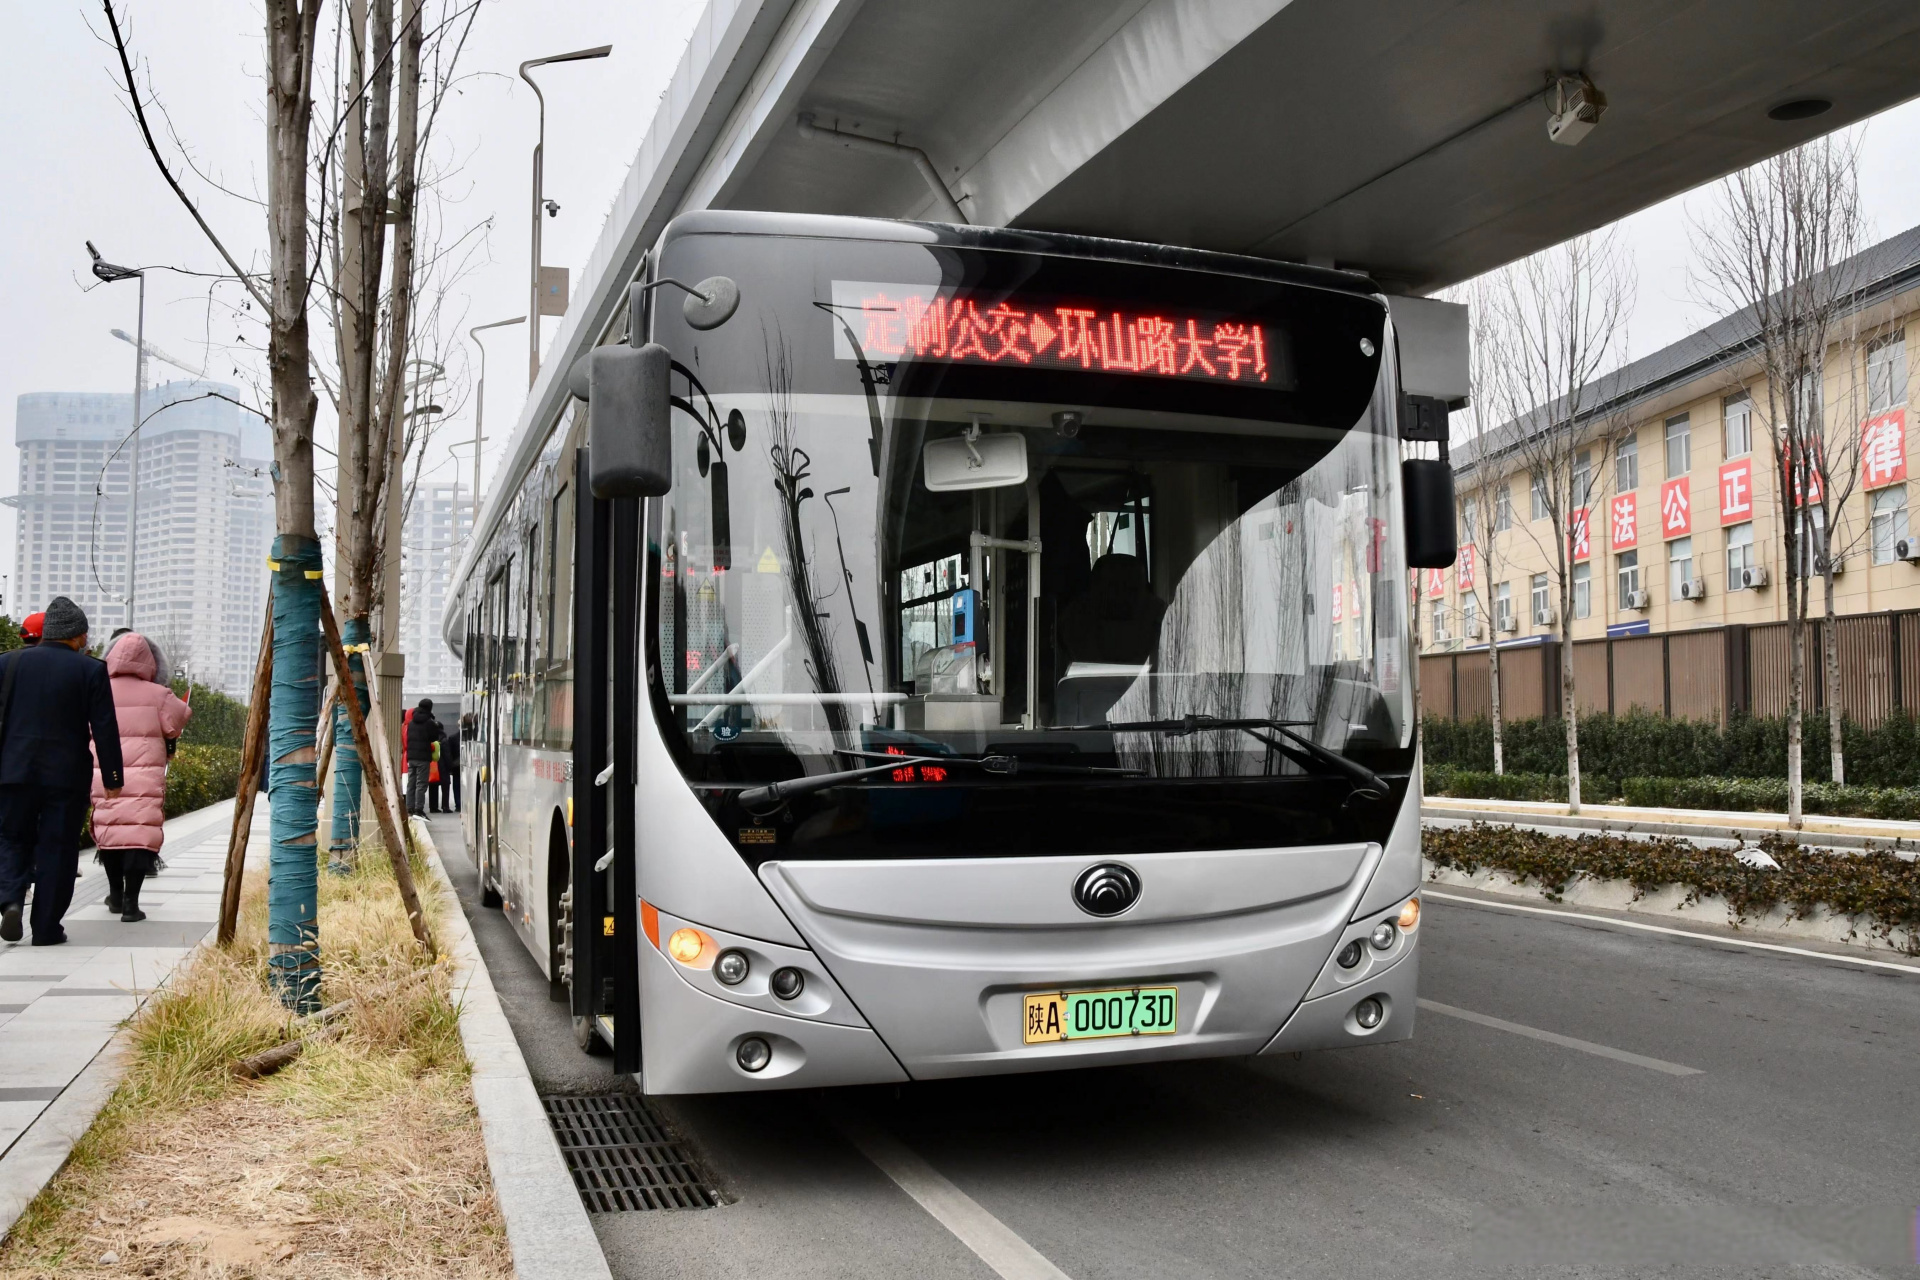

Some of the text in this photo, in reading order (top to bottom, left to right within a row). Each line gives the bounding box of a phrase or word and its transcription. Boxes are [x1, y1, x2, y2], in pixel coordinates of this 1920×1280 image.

[861, 293, 1032, 364] 定制公交
[1075, 994, 1174, 1032] 00073D
